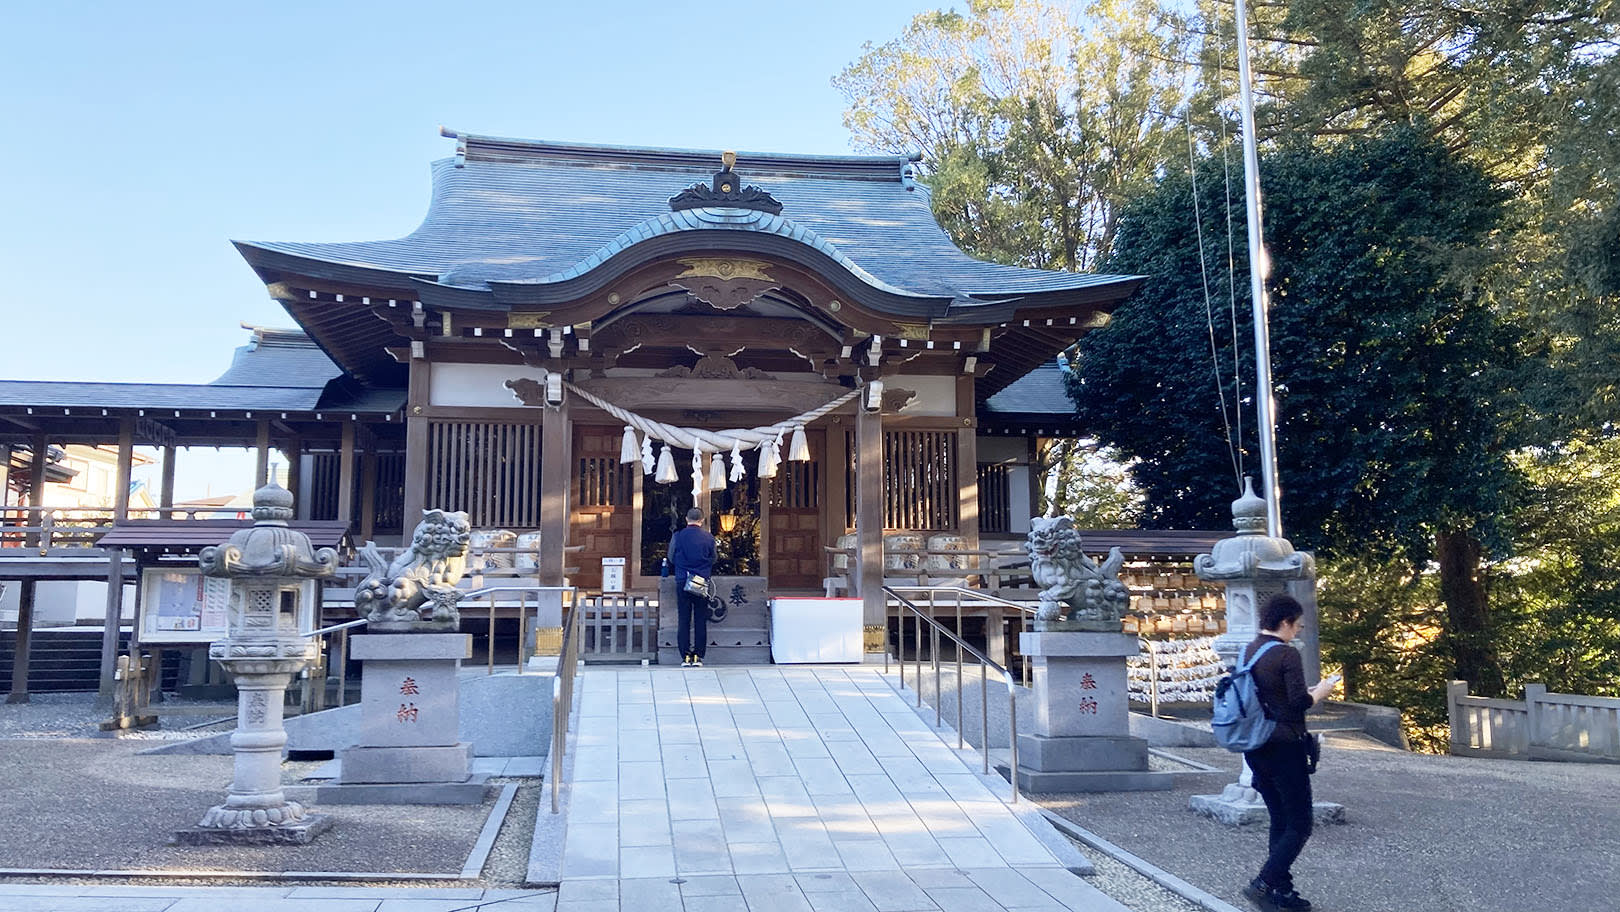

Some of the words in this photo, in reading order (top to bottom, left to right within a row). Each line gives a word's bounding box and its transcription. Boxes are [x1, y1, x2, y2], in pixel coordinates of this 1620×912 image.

[729, 584, 748, 607] 奉
[397, 677, 420, 723] 奉納
[1079, 672, 1098, 715] 奉納
